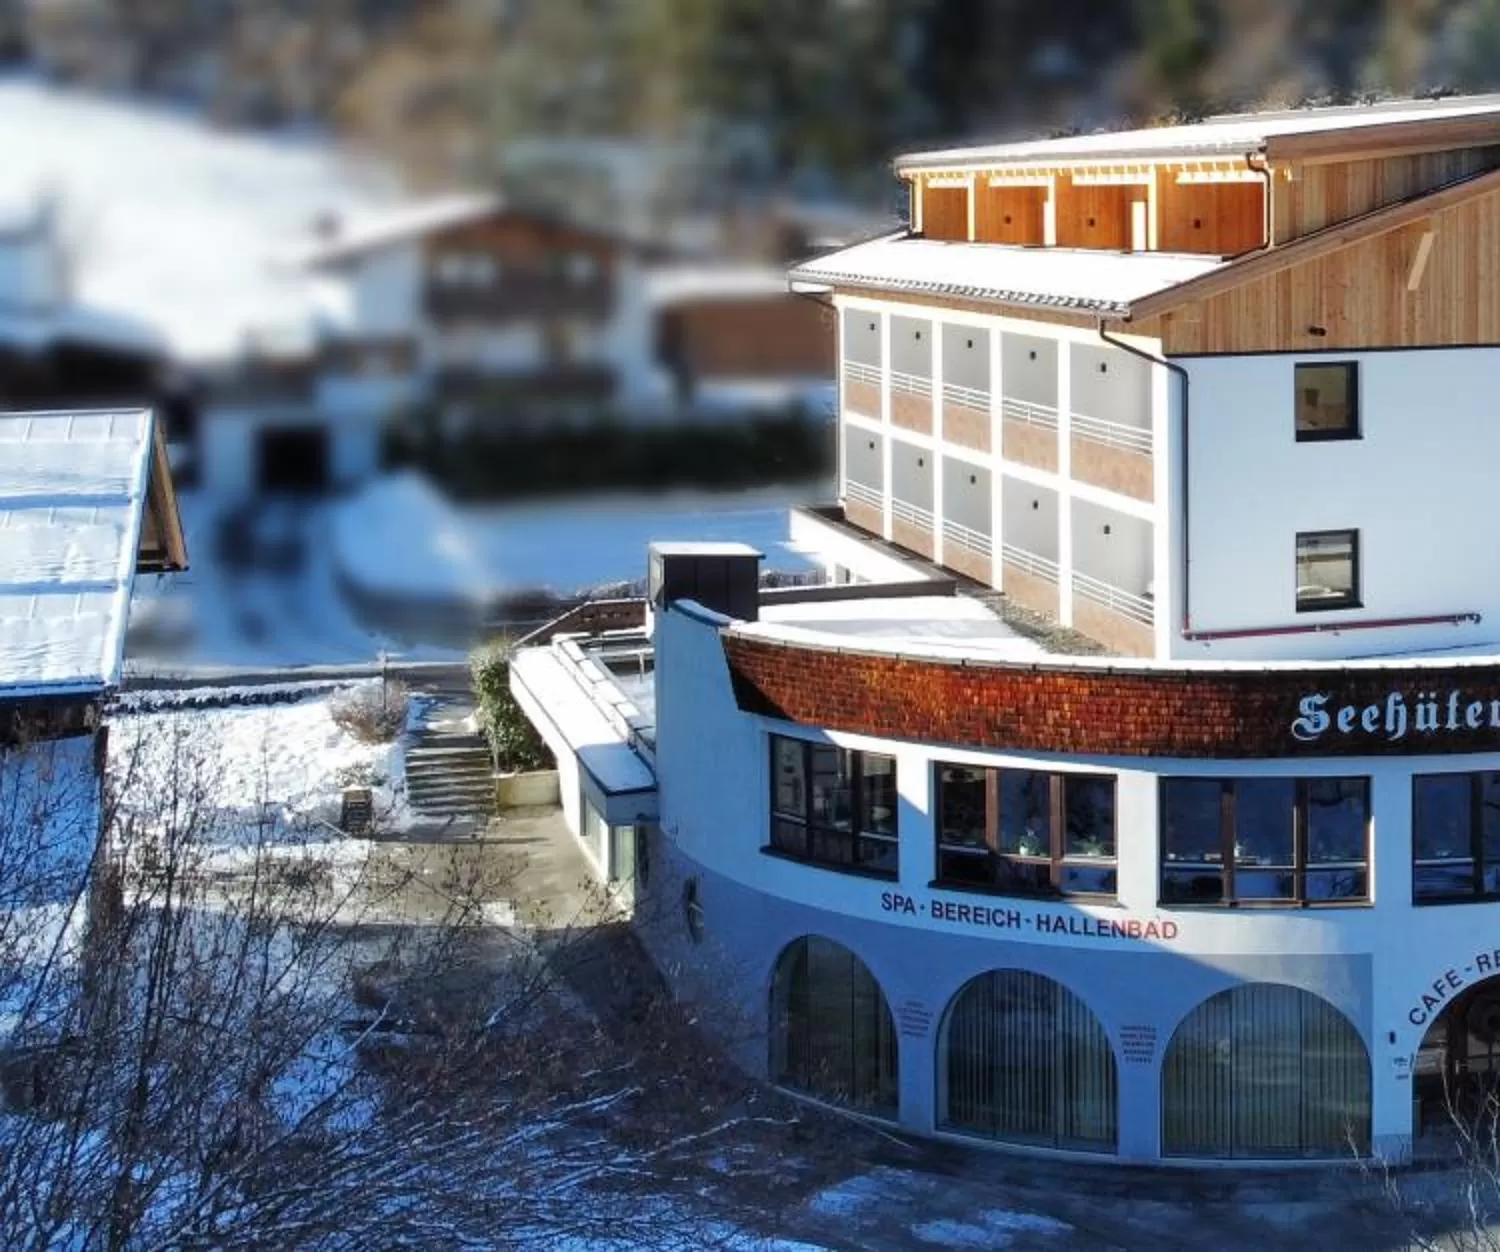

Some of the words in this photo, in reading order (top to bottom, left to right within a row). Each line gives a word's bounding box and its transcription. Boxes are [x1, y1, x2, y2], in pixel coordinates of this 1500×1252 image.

[880, 892, 917, 916] SPA
[930, 899, 1022, 929] BEREICH
[1035, 913, 1179, 941] HALLENBAD
